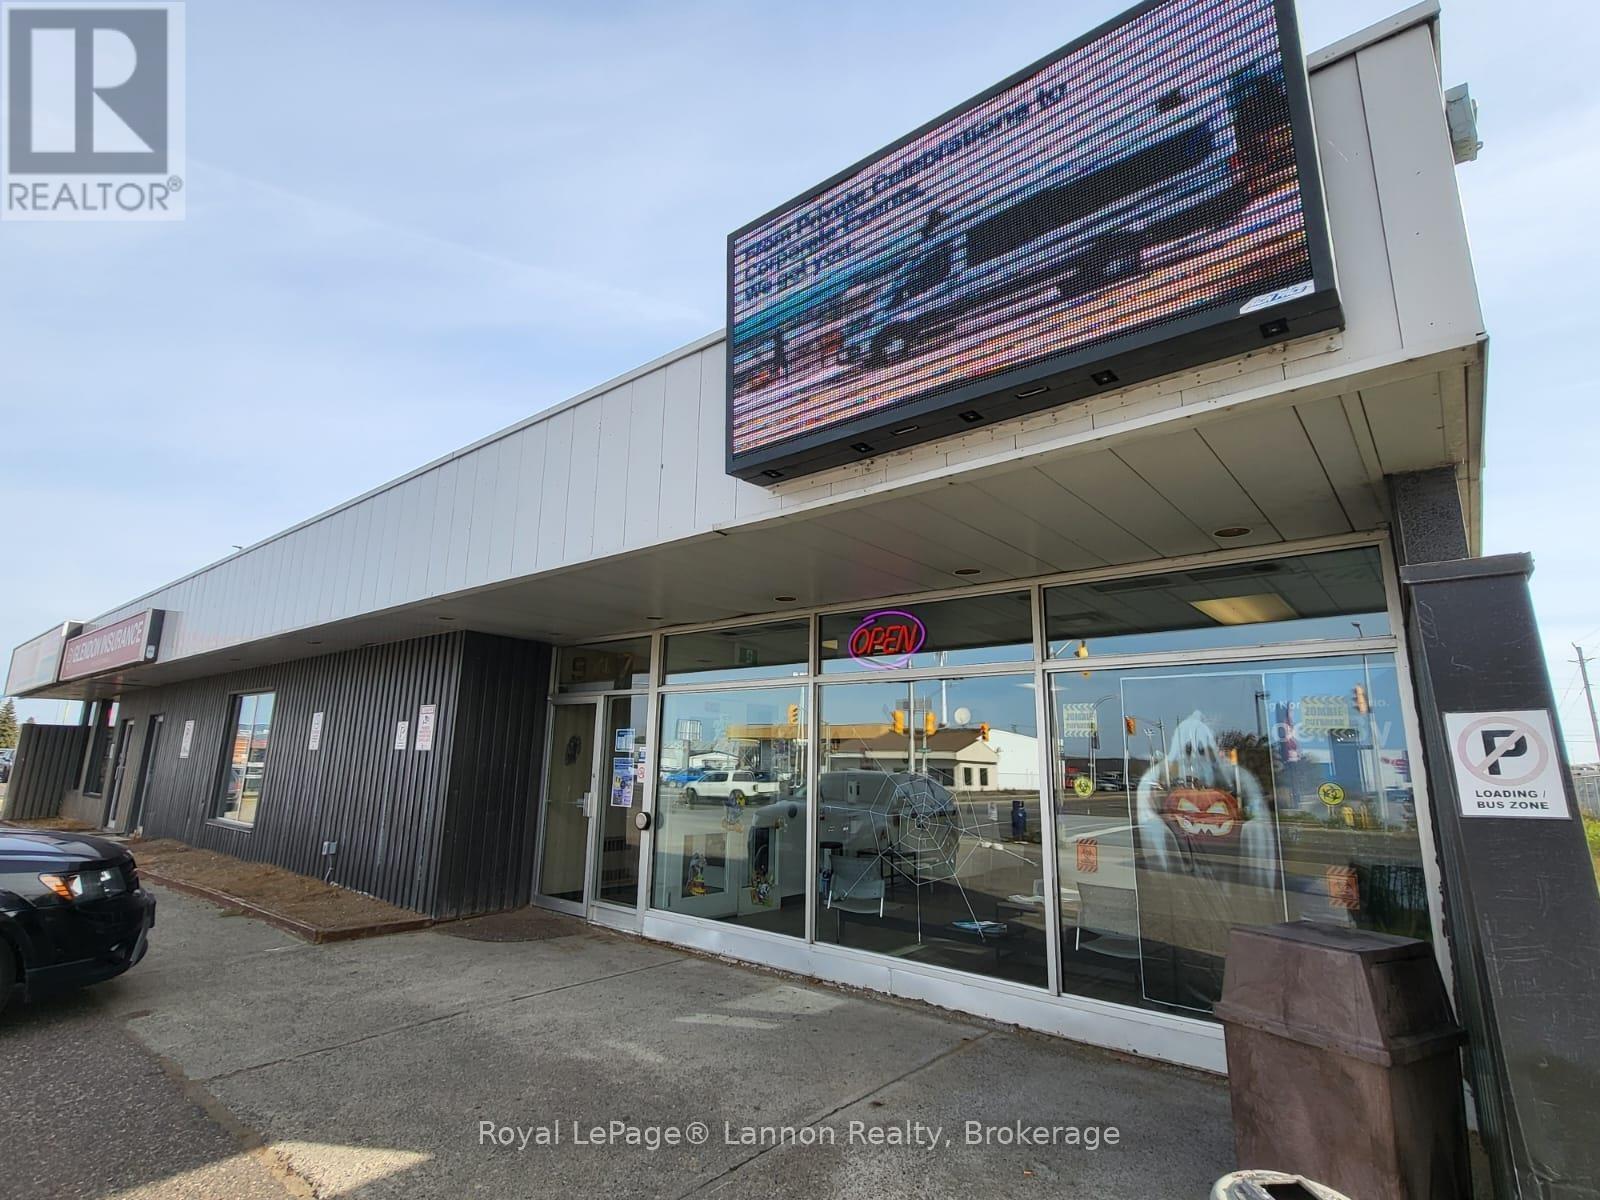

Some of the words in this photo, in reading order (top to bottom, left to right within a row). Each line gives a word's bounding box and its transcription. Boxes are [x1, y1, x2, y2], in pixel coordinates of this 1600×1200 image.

[101, 621, 144, 654] INSURANCE
[851, 623, 919, 656] OPEN
[1475, 789, 1538, 799] LOADING
[1477, 801, 1505, 809] BUS
[1509, 801, 1550, 810] ZONE
